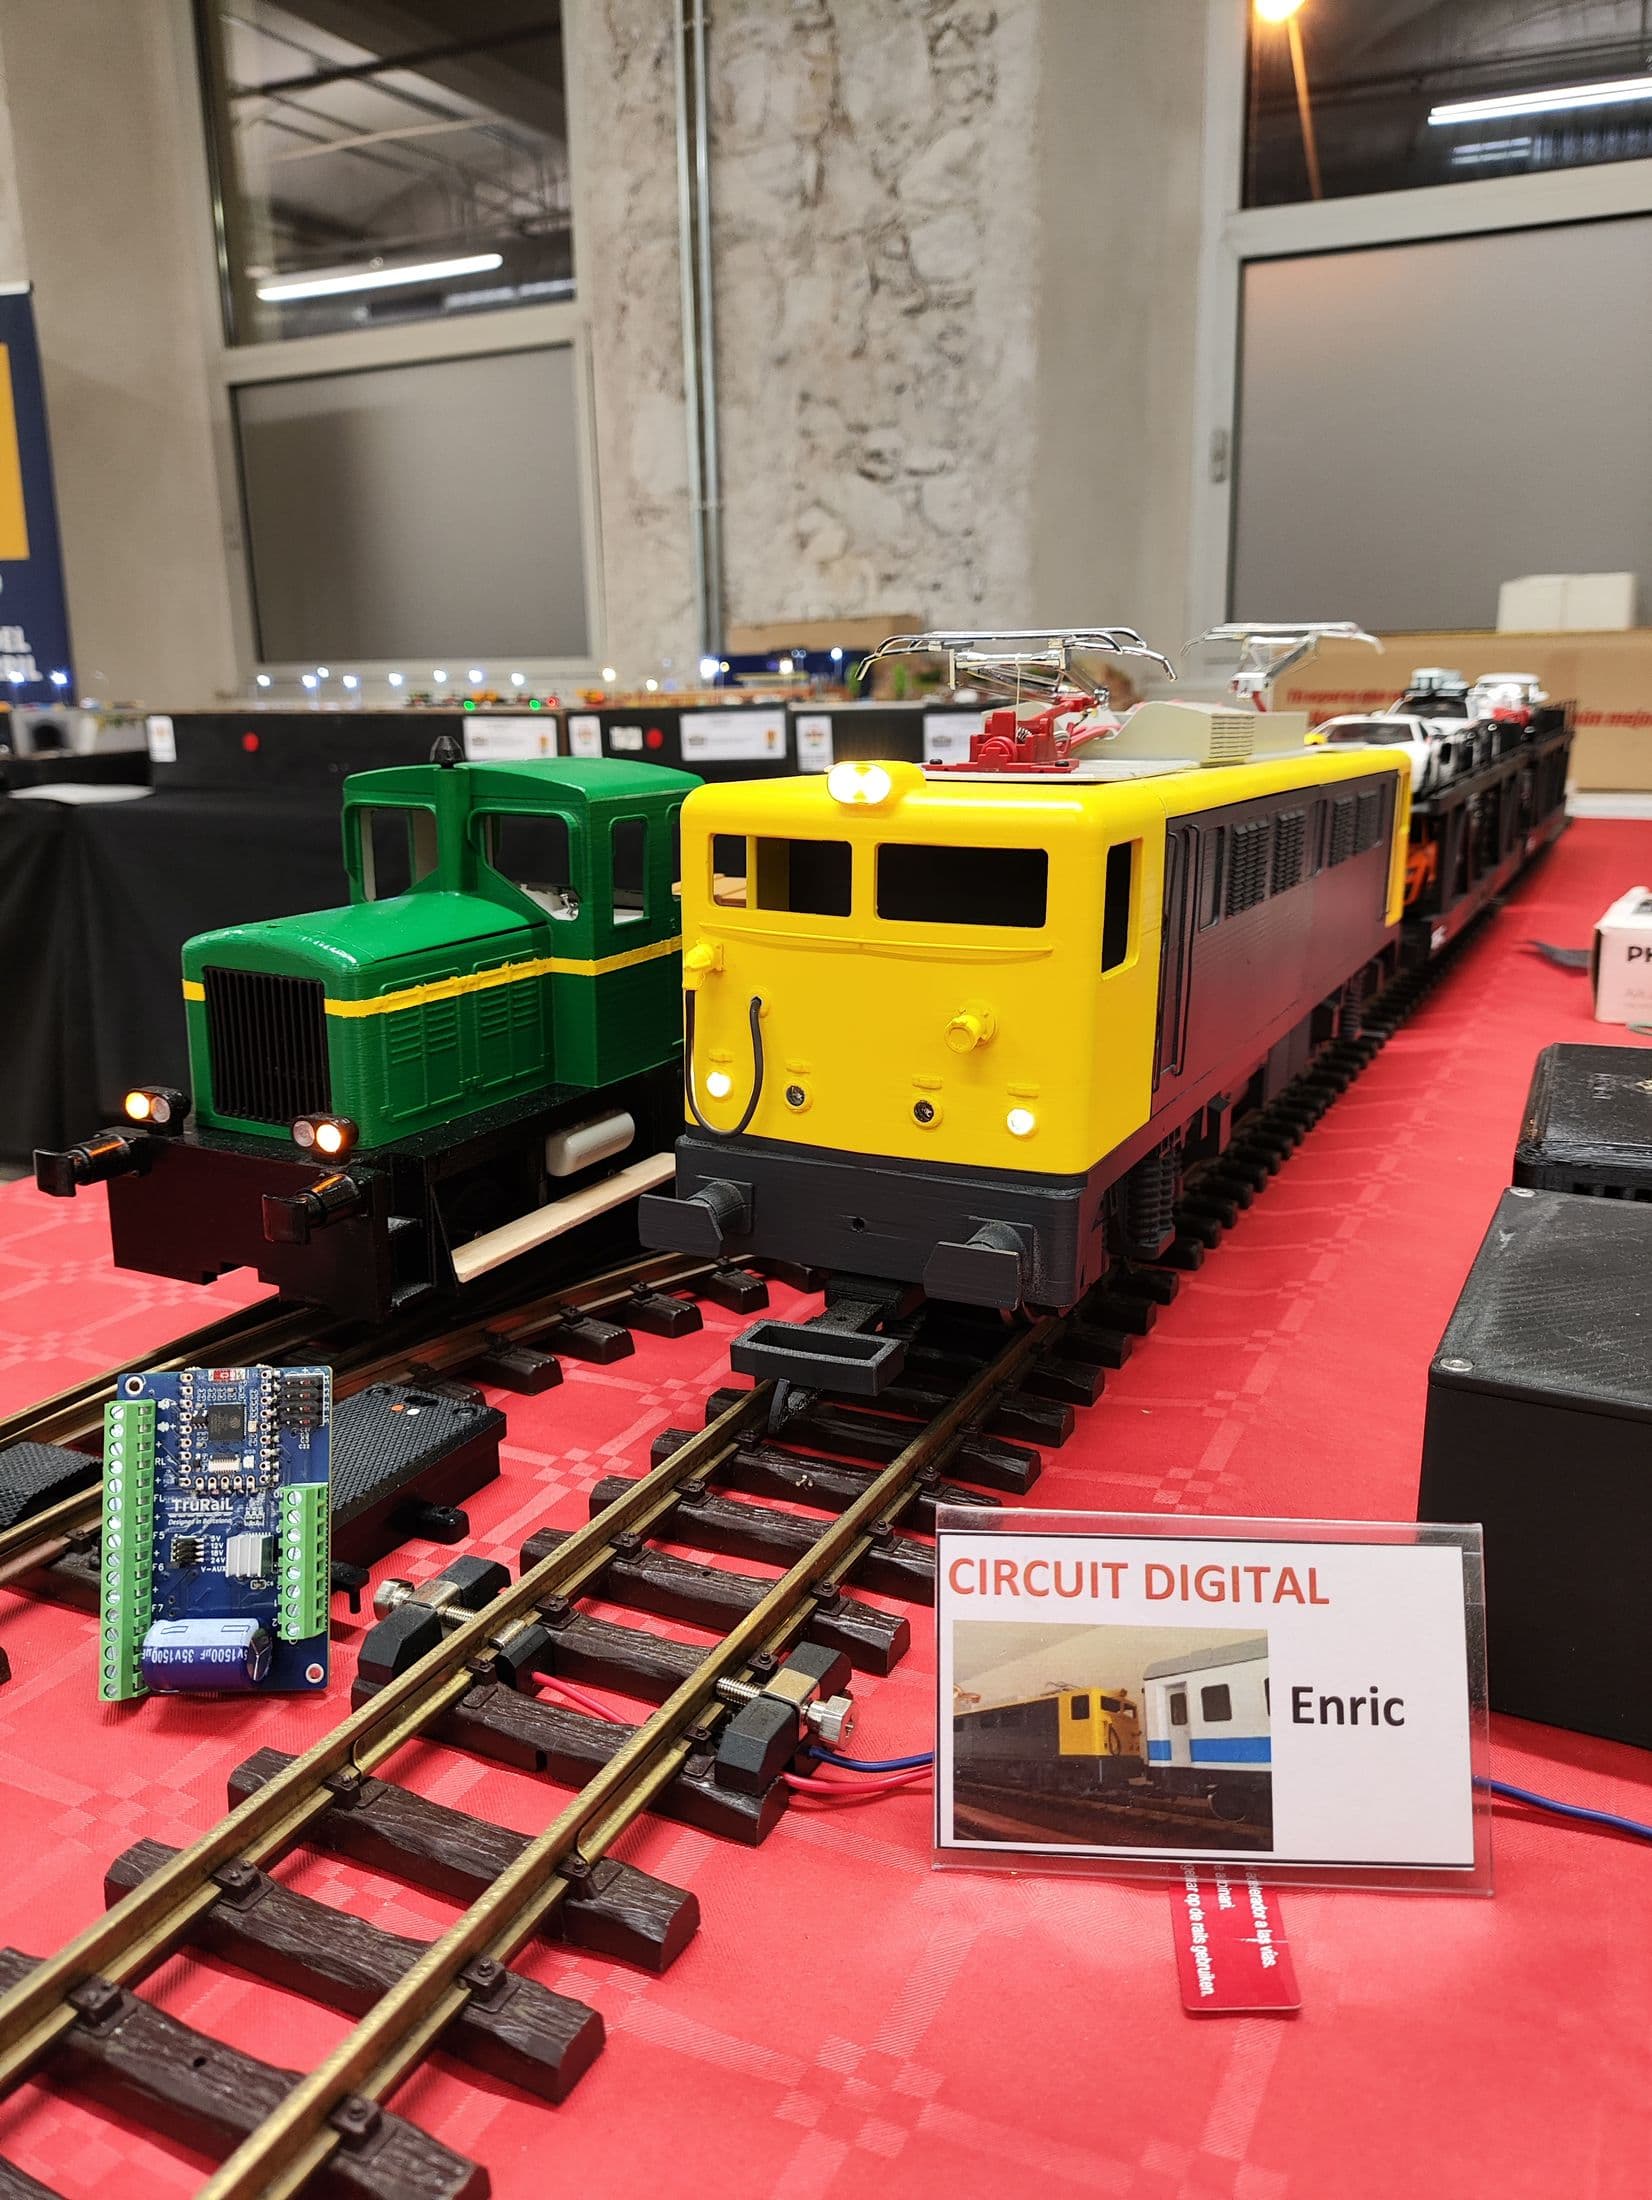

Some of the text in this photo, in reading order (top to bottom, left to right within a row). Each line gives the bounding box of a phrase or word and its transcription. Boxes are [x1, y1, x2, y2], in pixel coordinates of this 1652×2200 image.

[155, 1457, 166, 1466] RL
[153, 1494, 166, 1503] FL
[152, 1531, 166, 1541] F5
[151, 1563, 165, 1572] F6
[949, 1558, 1329, 1604] CIRCUIT DIGITAL
[151, 1604, 164, 1613] F7
[1292, 1686, 1405, 1727] Enric
[1184, 1893, 1201, 1907] op
[1188, 1907, 1206, 1921] de
[1254, 1920, 1269, 1928] a
[1191, 1922, 1209, 1945] rails
[1256, 1929, 1273, 1944] las
[1189, 1945, 1216, 1998] gebruiken.
